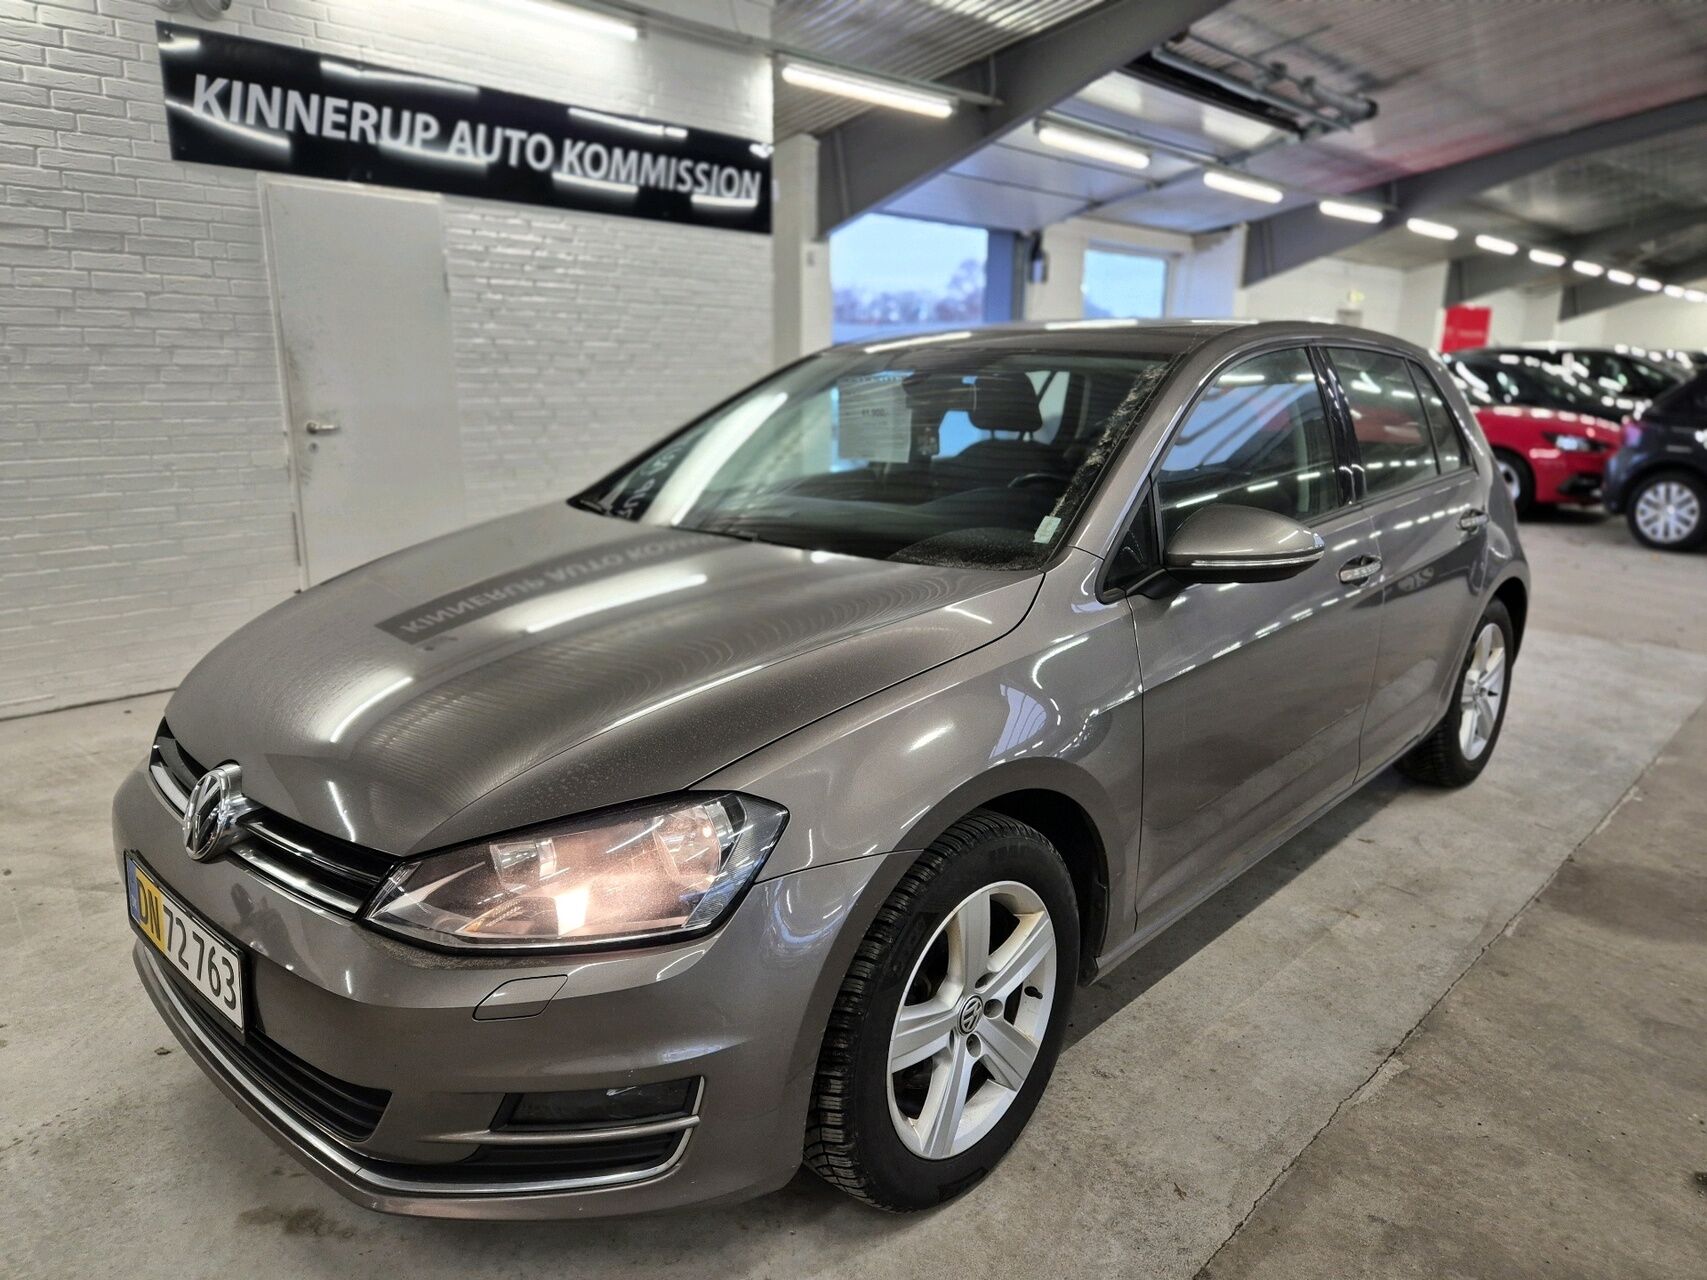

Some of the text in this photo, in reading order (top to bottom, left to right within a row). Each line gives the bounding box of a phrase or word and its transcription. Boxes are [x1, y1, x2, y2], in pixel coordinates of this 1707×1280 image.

[192, 74, 762, 200] KINNERUP AUTO KOMMISSION
